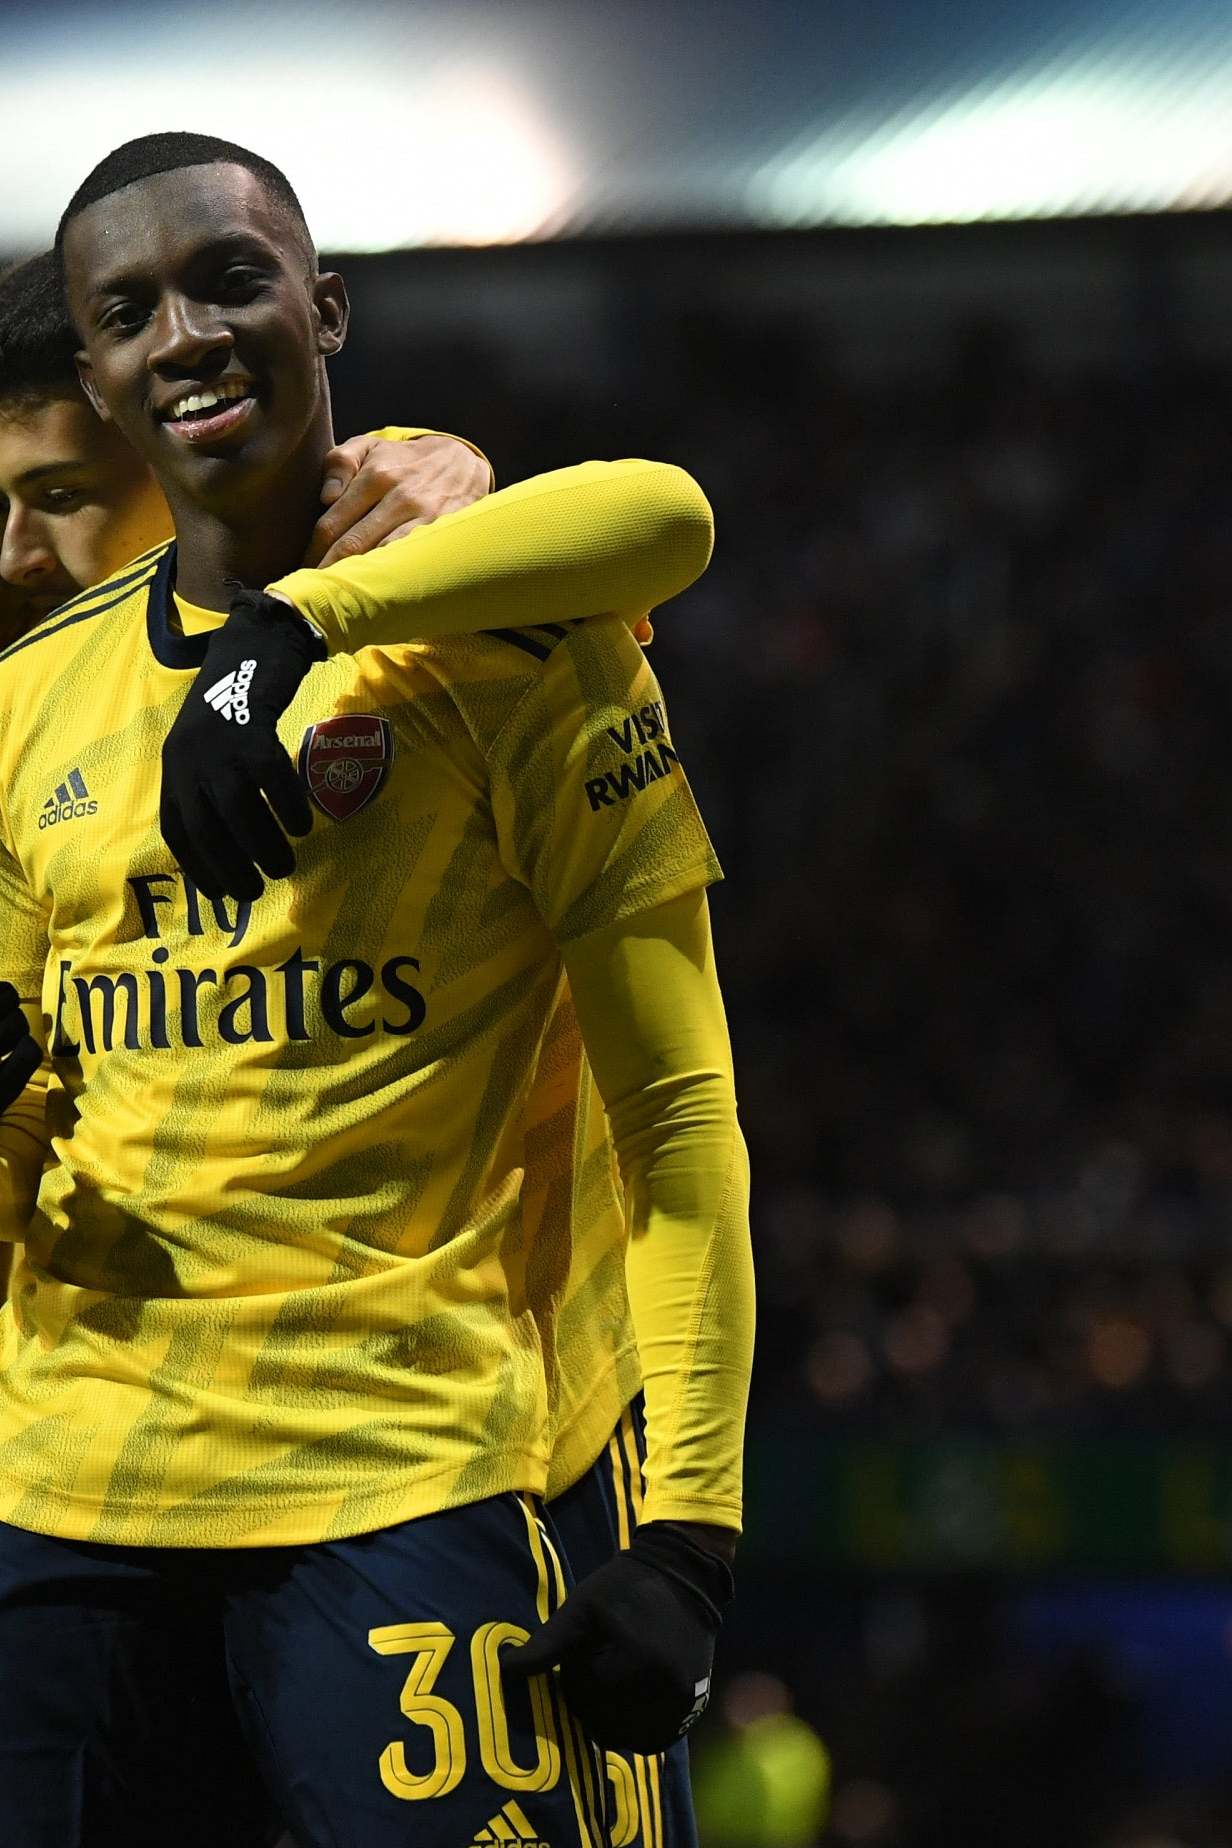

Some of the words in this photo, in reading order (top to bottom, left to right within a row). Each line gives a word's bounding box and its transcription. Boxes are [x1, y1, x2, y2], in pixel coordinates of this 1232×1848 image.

[230, 659, 258, 725] adidas
[312, 730, 381, 750] Arsenal
[37, 797, 98, 831] adidas
[126, 868, 252, 949] Fly
[368, 1621, 561, 1801] 30
